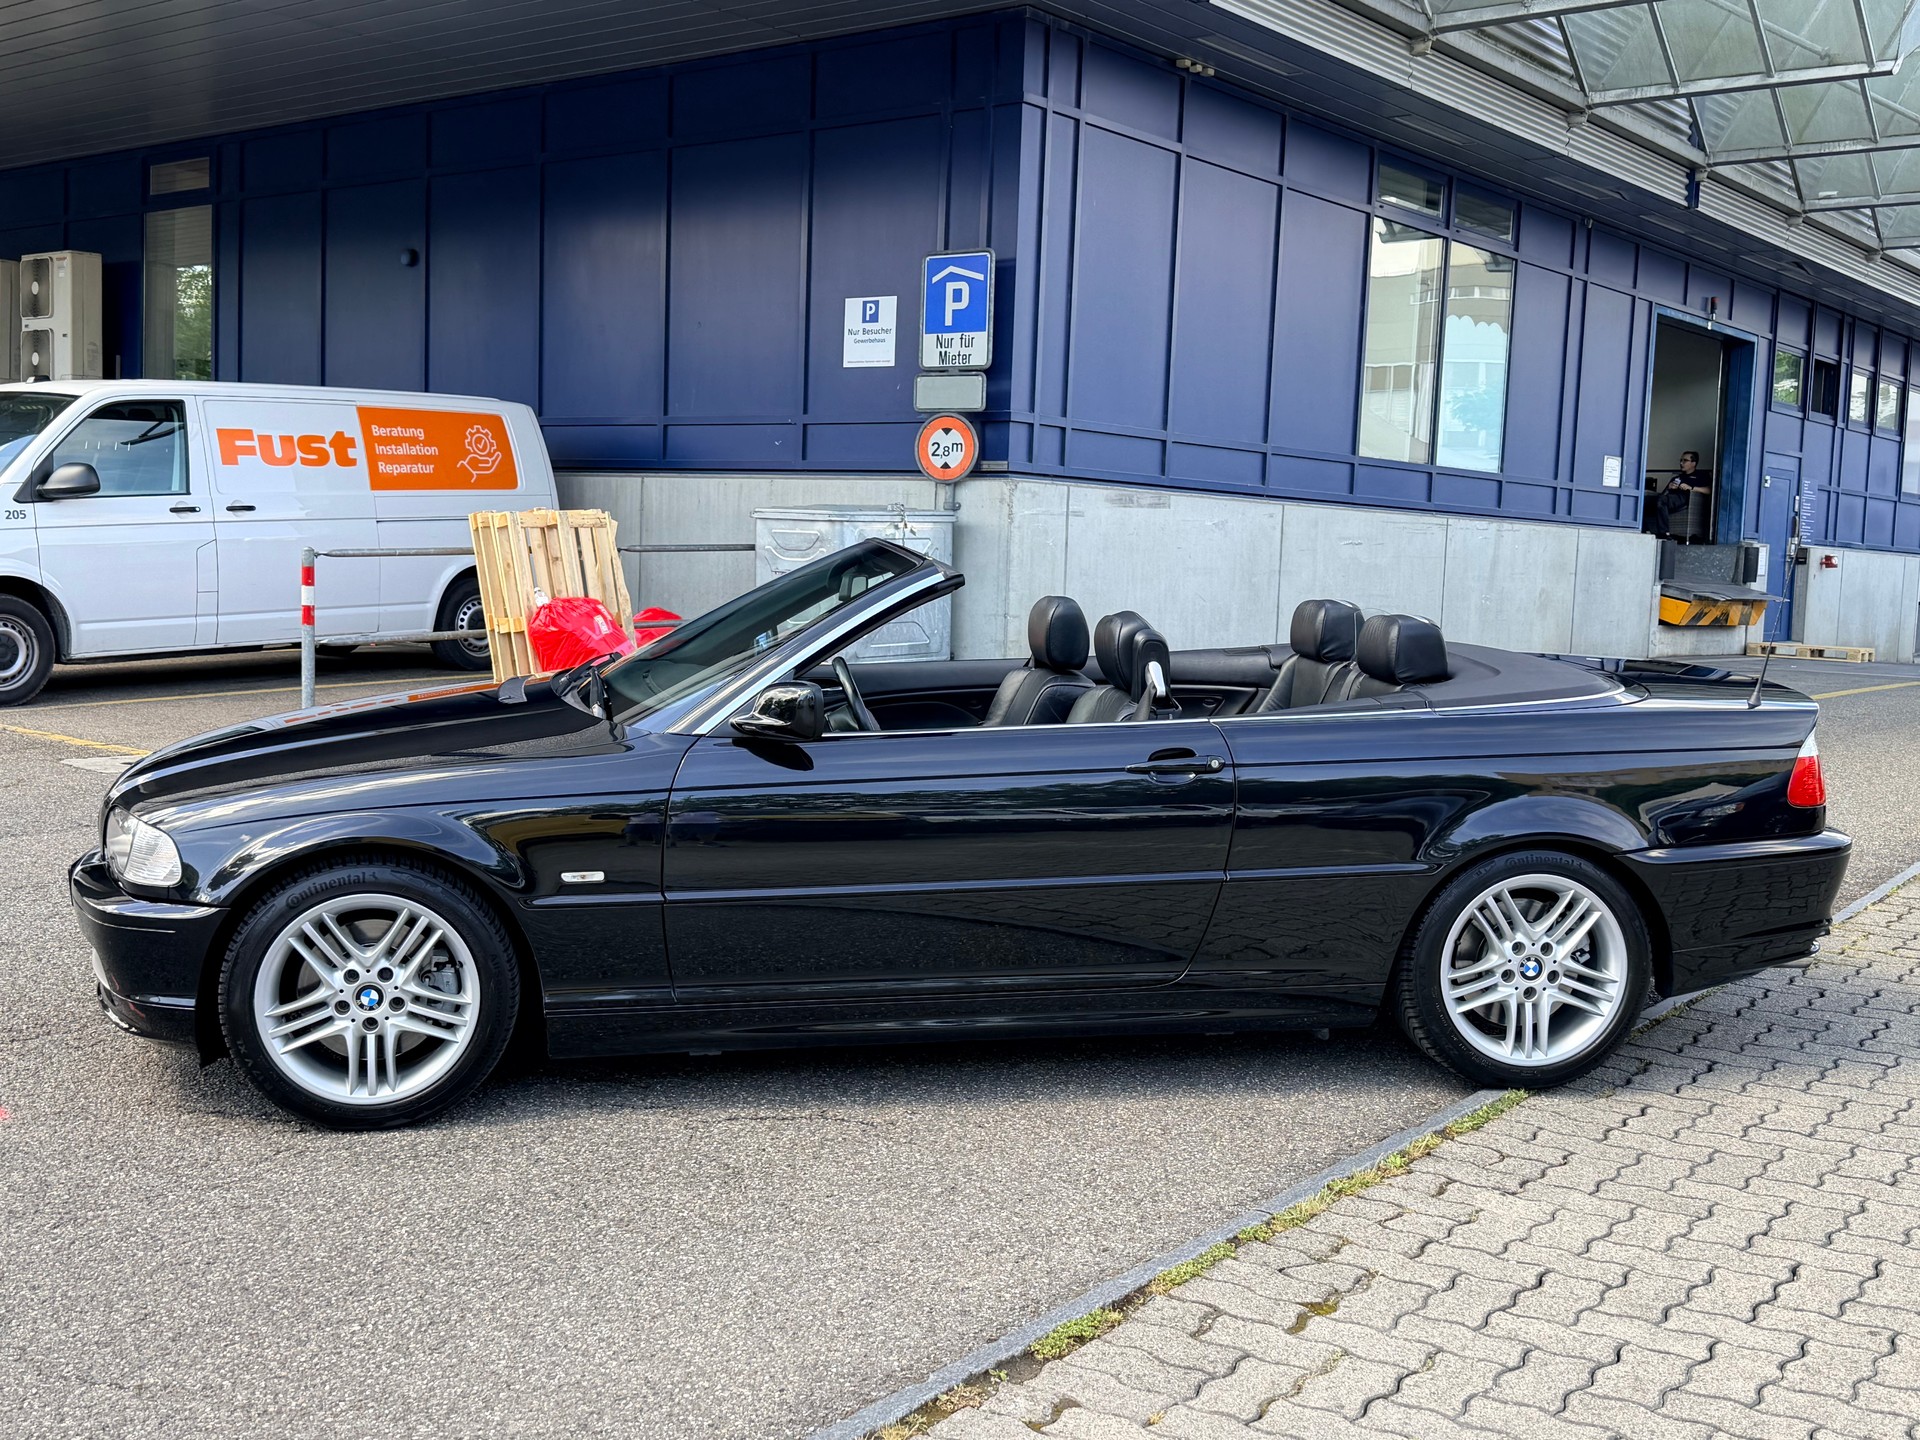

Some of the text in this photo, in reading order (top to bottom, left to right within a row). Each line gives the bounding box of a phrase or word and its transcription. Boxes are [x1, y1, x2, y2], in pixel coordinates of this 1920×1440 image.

[945, 281, 969, 326] P
[866, 303, 876, 321] P
[862, 327, 892, 335] Besucher
[936, 333, 975, 349] Nur für
[938, 350, 972, 365] Mieter
[371, 424, 424, 440] Beratung
[216, 428, 357, 467] Fust
[375, 443, 439, 456] Installation
[378, 461, 435, 476] Reparatur
[5, 509, 27, 520] 205
[286, 871, 366, 908] Continental
